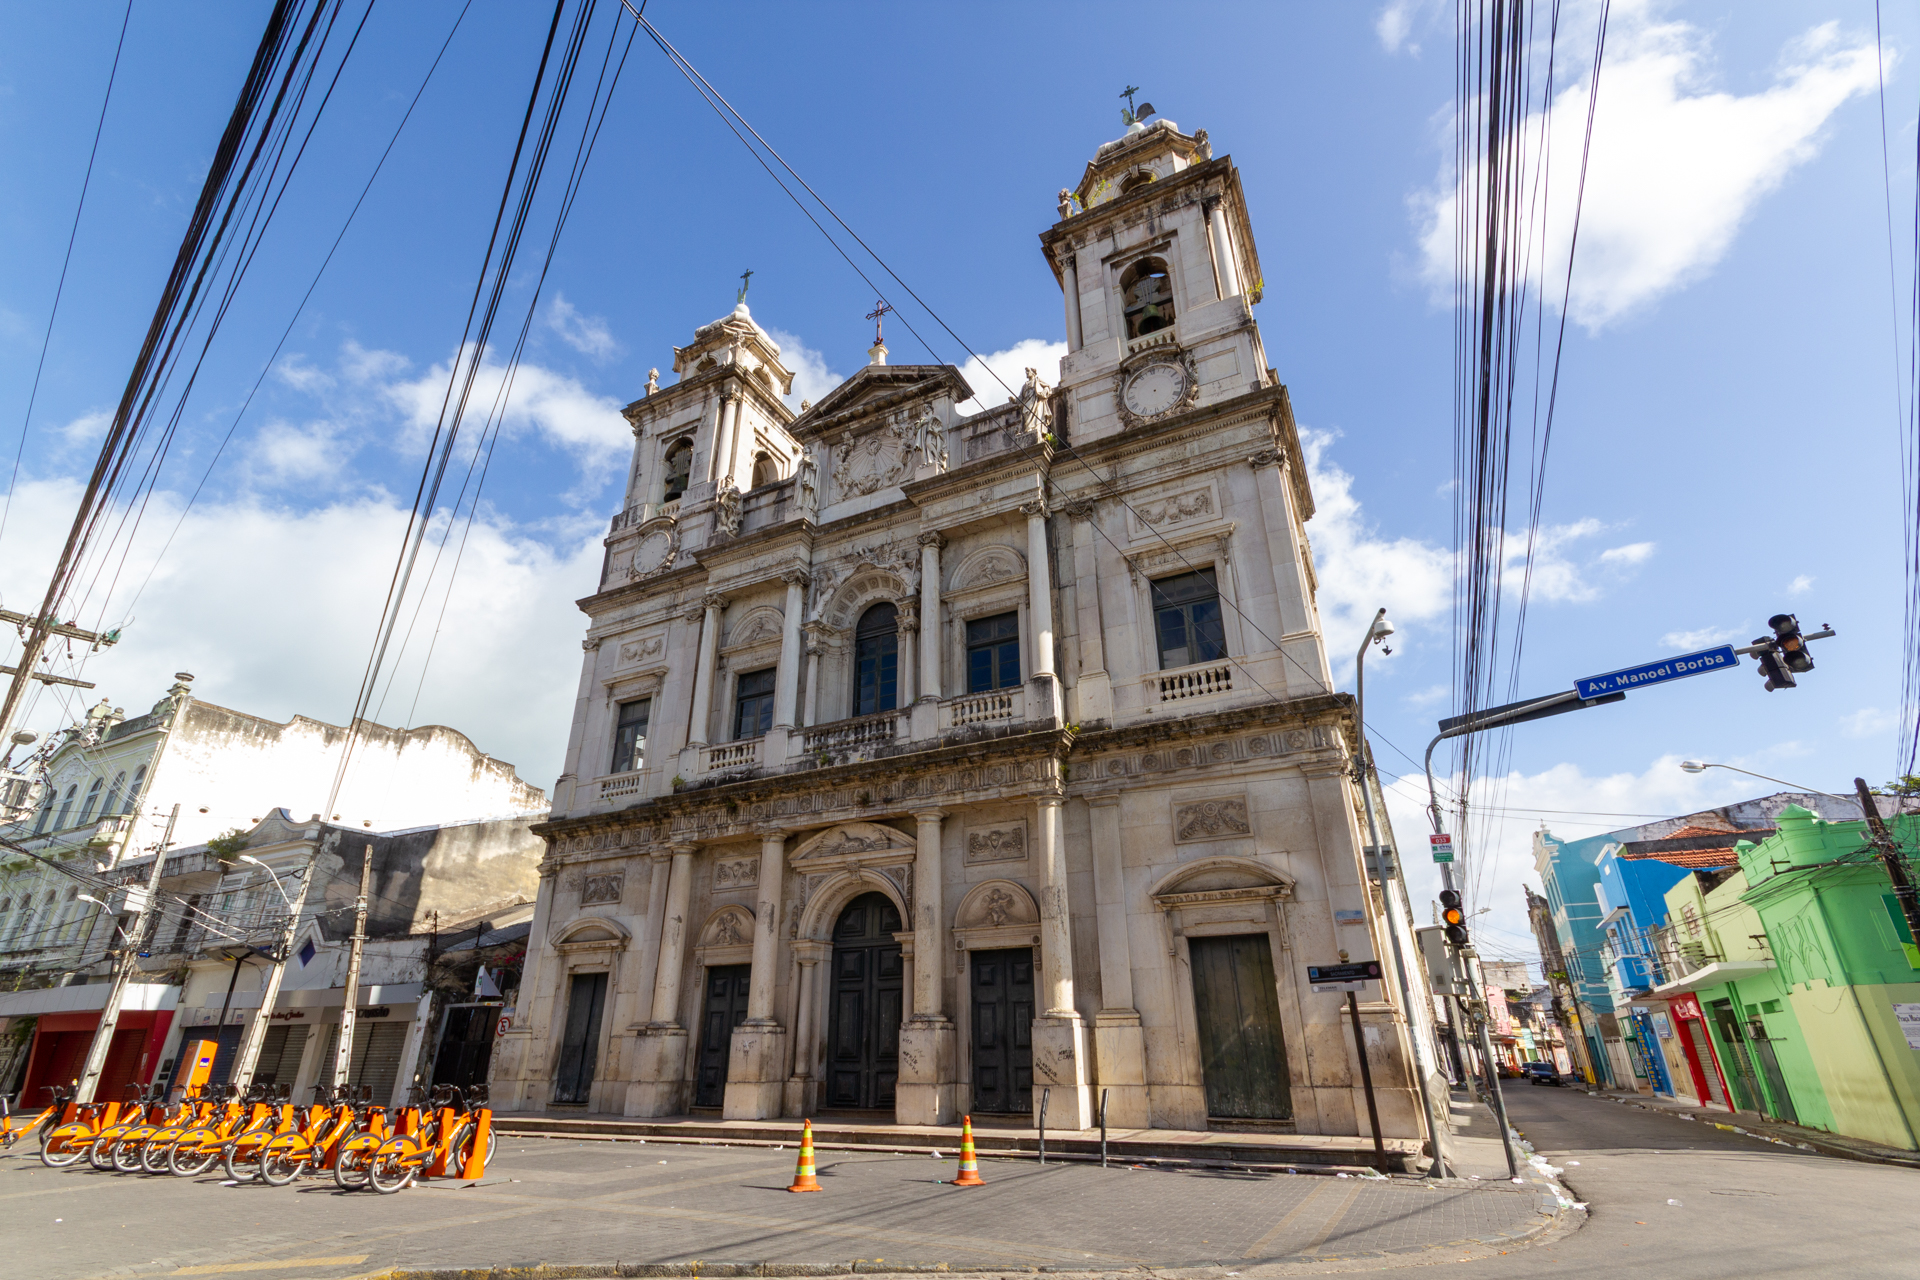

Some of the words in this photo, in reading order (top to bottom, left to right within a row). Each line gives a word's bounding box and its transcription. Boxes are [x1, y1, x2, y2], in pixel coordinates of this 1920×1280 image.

[1588, 682, 1613, 693] Av.
[1615, 664, 1672, 686] Manoel
[1675, 654, 1725, 673] Borba
